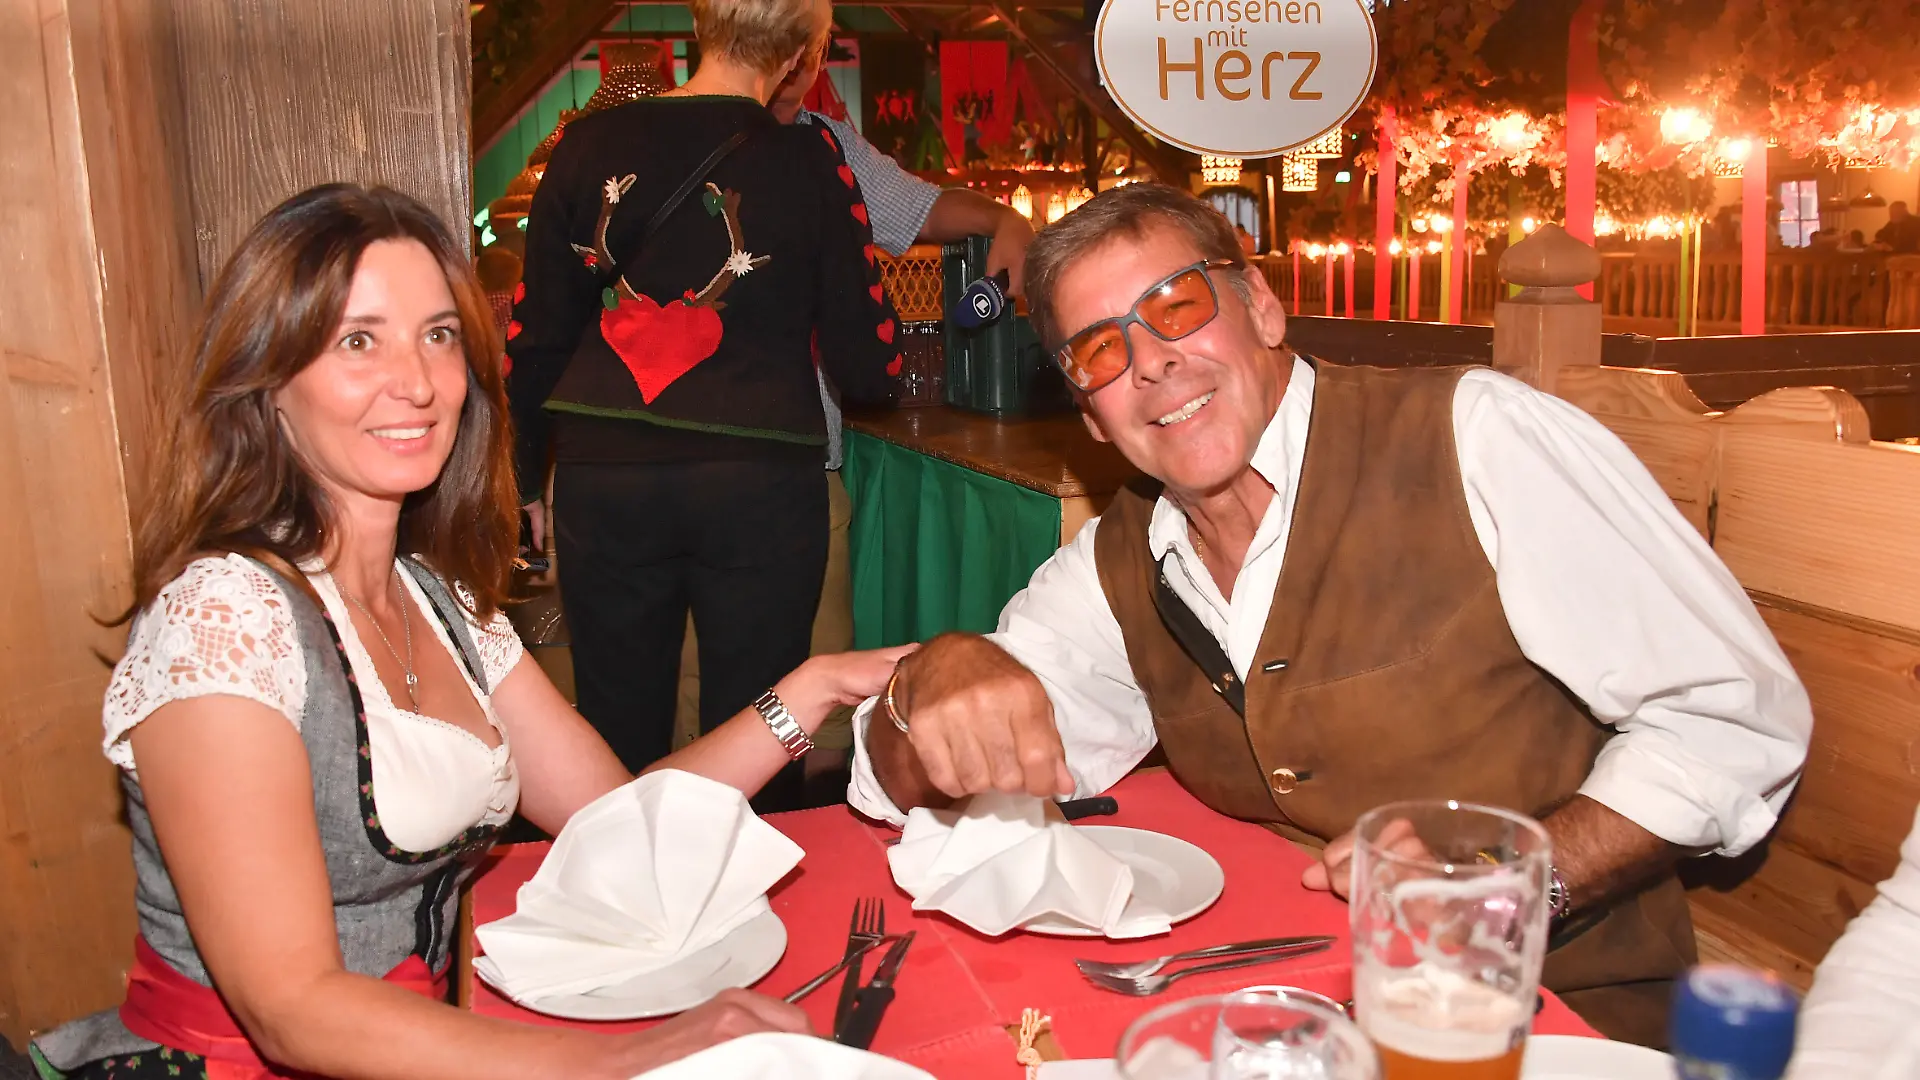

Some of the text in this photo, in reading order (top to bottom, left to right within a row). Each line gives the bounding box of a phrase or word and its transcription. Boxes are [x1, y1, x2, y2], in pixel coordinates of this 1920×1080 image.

[1156, 0, 1321, 23] Fernsehen
[1208, 25, 1248, 47] mit
[1157, 37, 1323, 101] Herz
